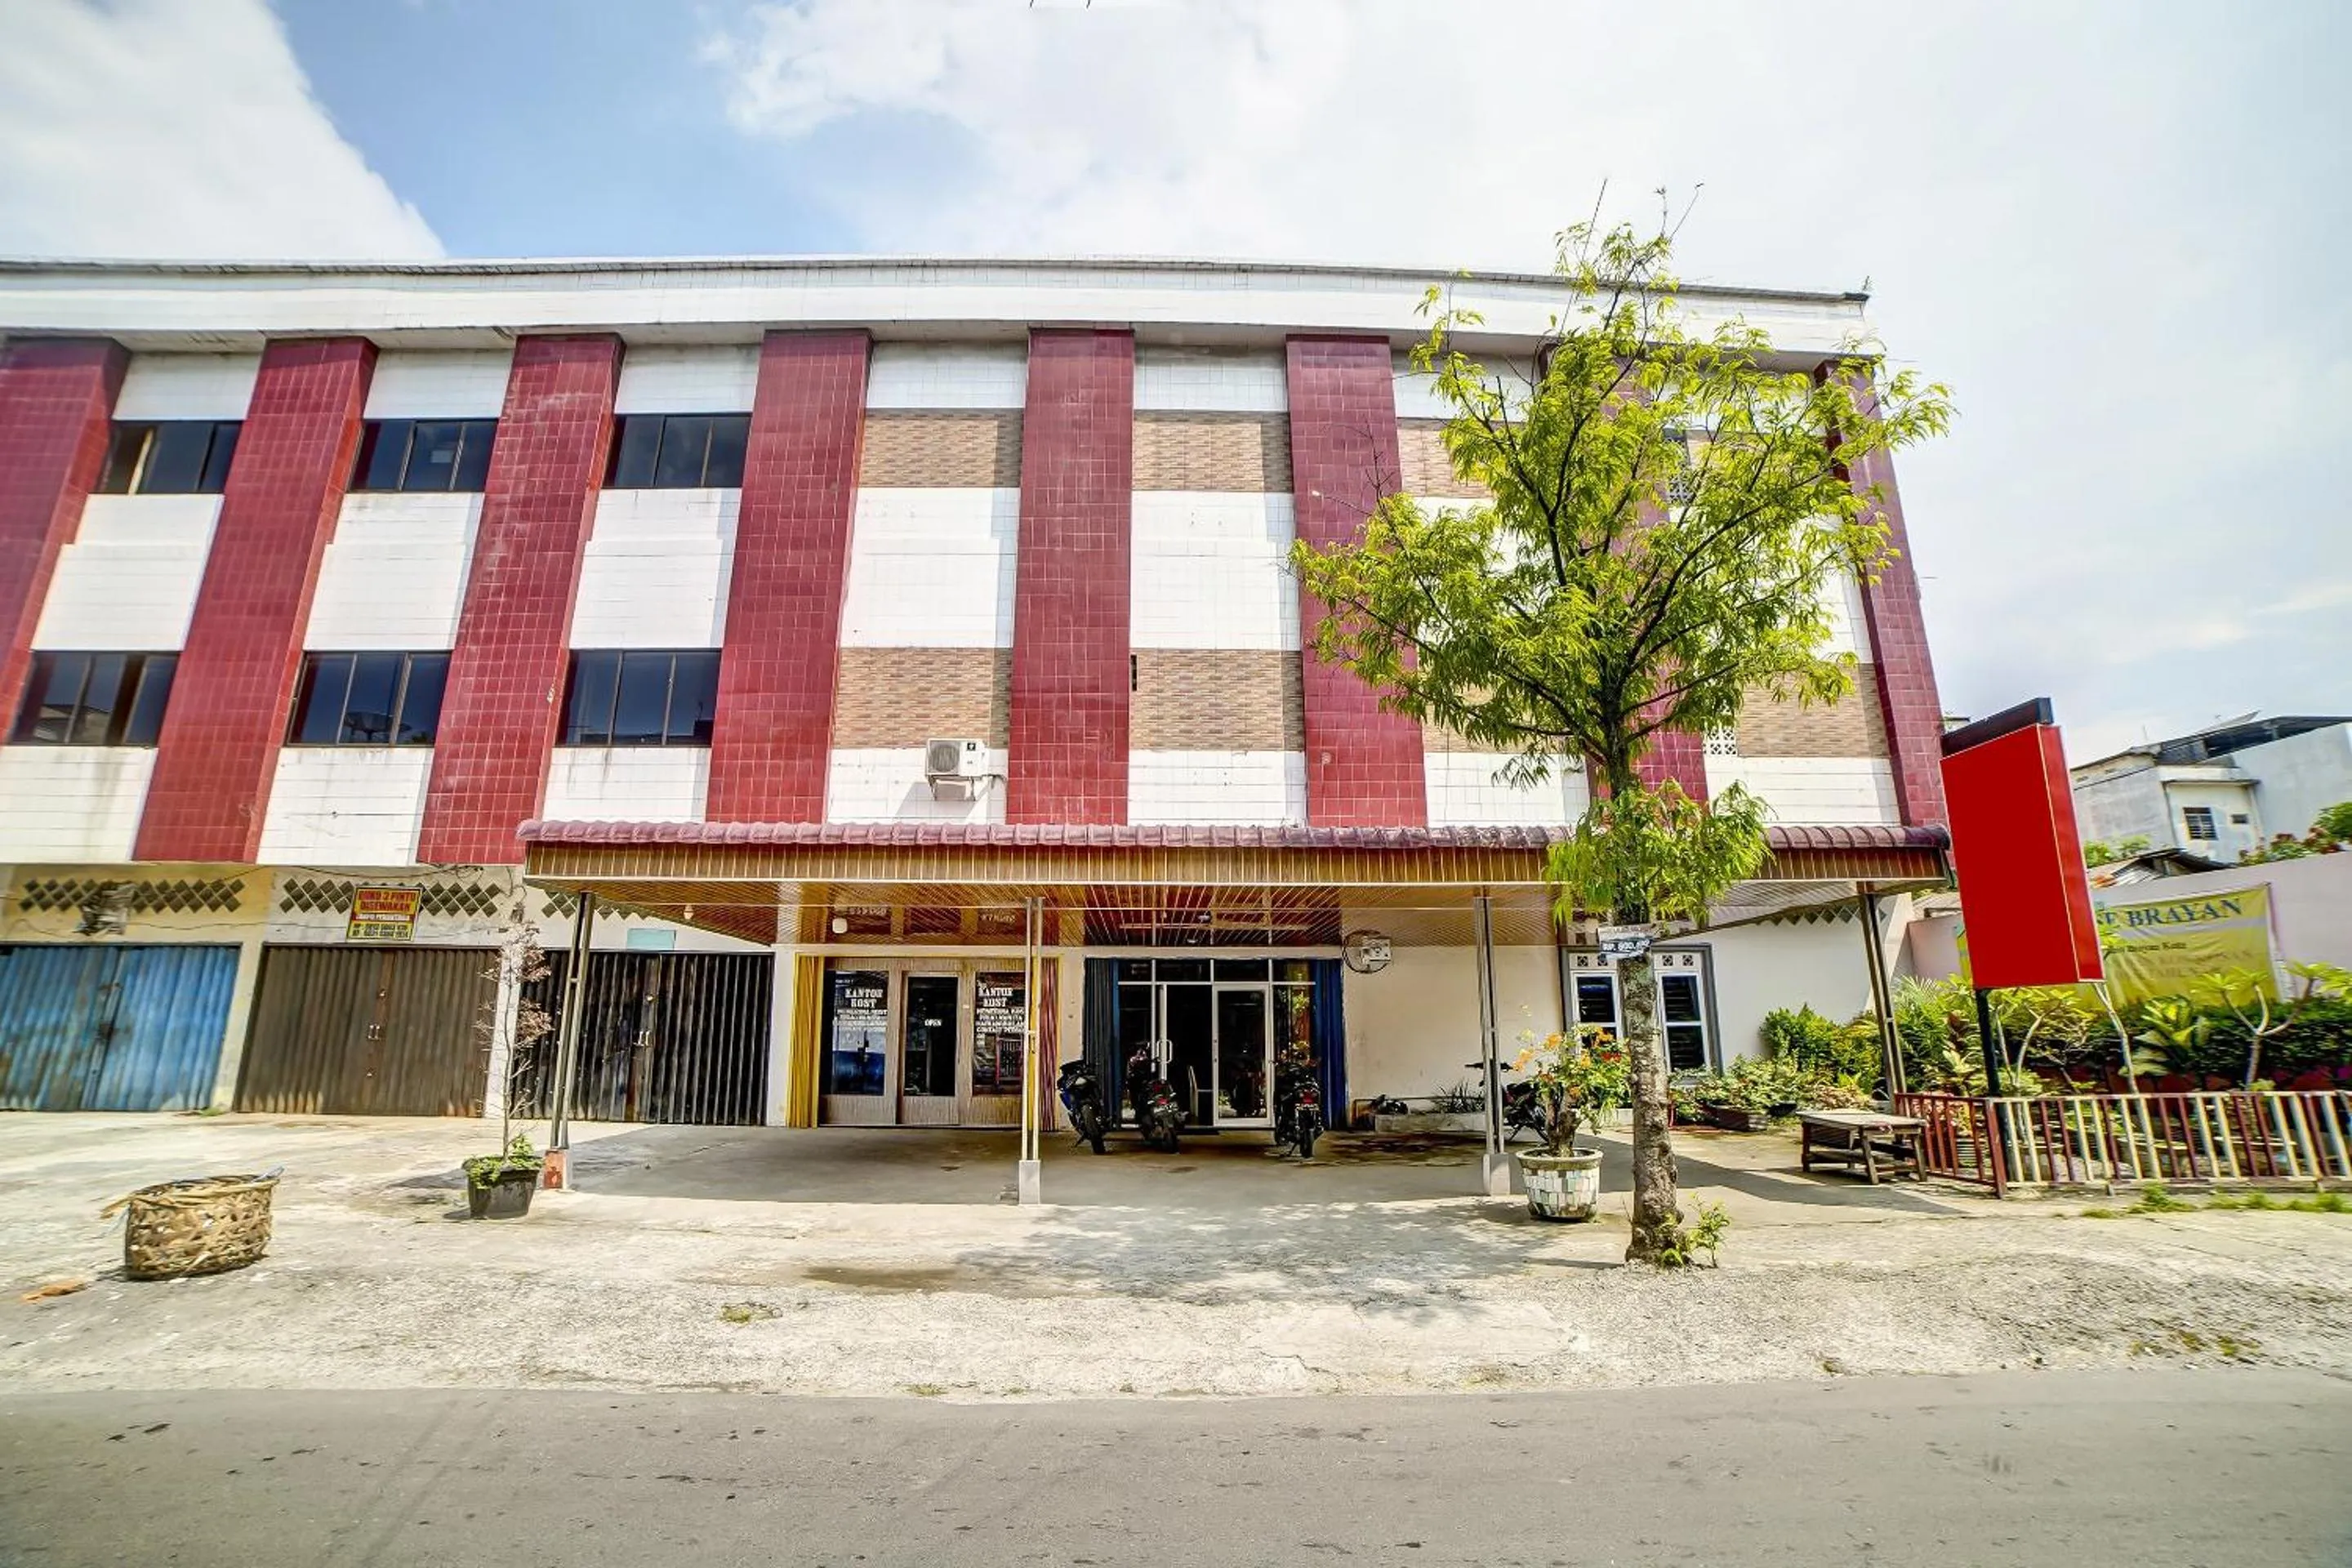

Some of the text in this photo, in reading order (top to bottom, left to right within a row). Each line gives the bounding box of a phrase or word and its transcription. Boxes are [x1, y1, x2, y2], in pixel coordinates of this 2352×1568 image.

[2126, 898, 2243, 927] BRAYAN
[845, 987, 884, 998] KANTOR
[978, 987, 1013, 997] KANTOR
[851, 998, 877, 1009] KOST
[982, 997, 1008, 1007] KOST
[924, 1018, 942, 1027] OPEN
